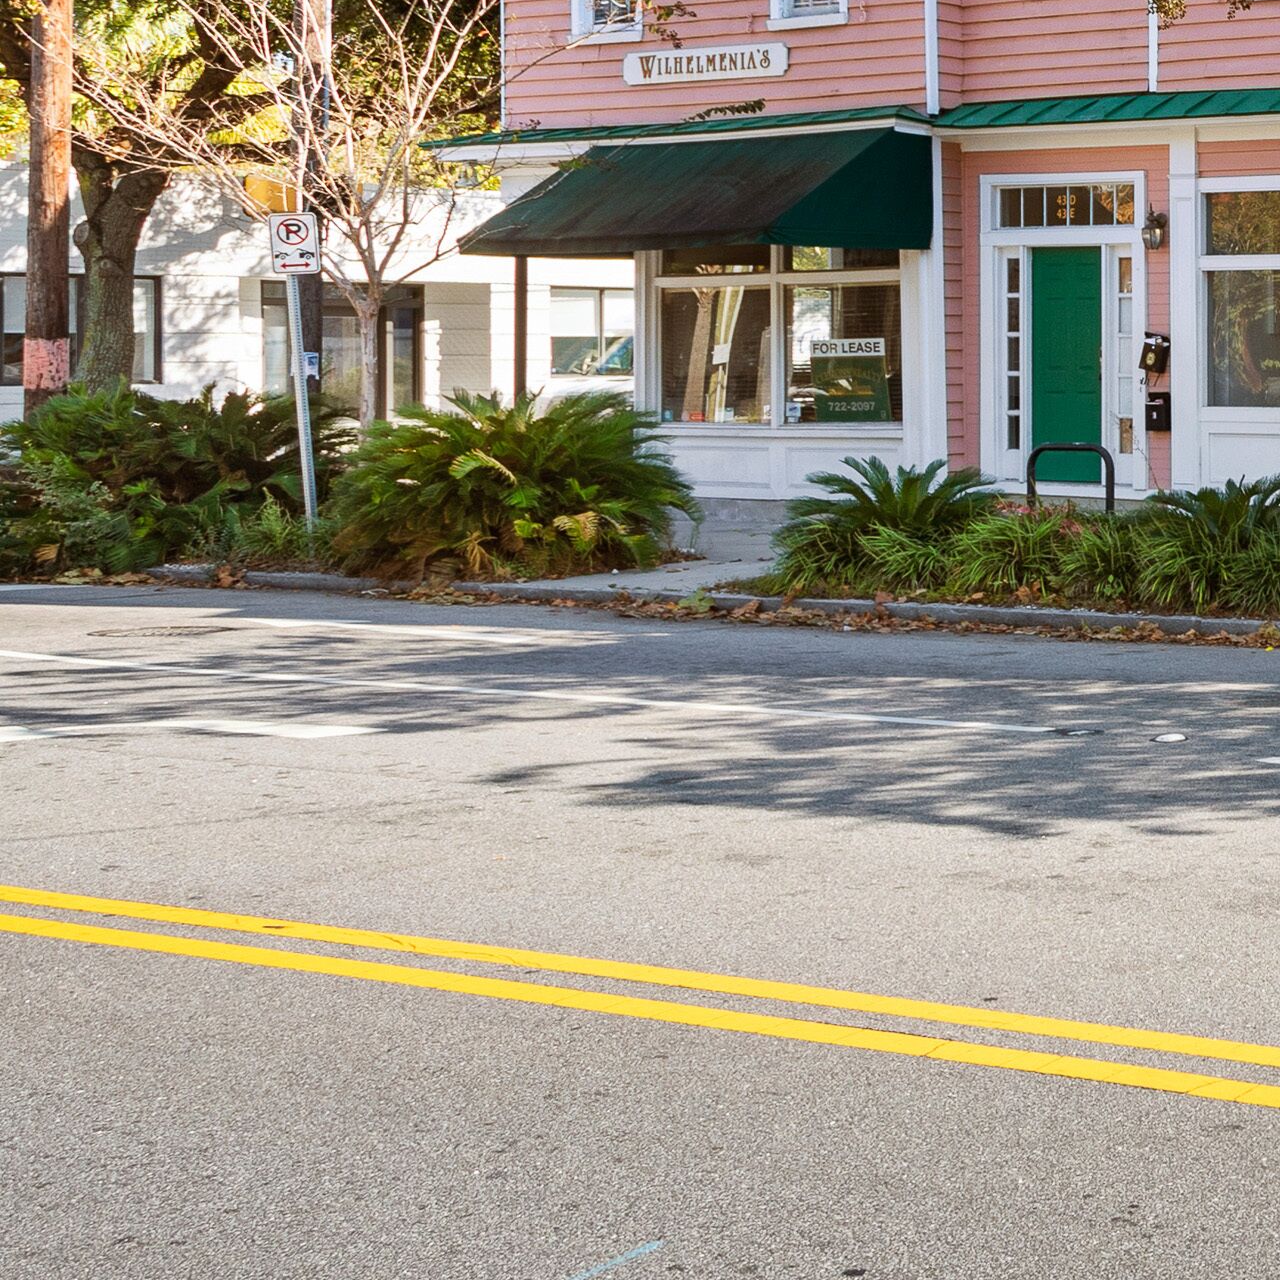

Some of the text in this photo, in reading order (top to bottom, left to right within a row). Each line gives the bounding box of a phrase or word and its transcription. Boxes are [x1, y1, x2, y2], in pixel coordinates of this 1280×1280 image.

[639, 48, 771, 79] WILHELMENIA'S
[285, 223, 301, 241] P
[813, 342, 881, 354] FOR LEASE
[828, 402, 876, 411] 722-2097
